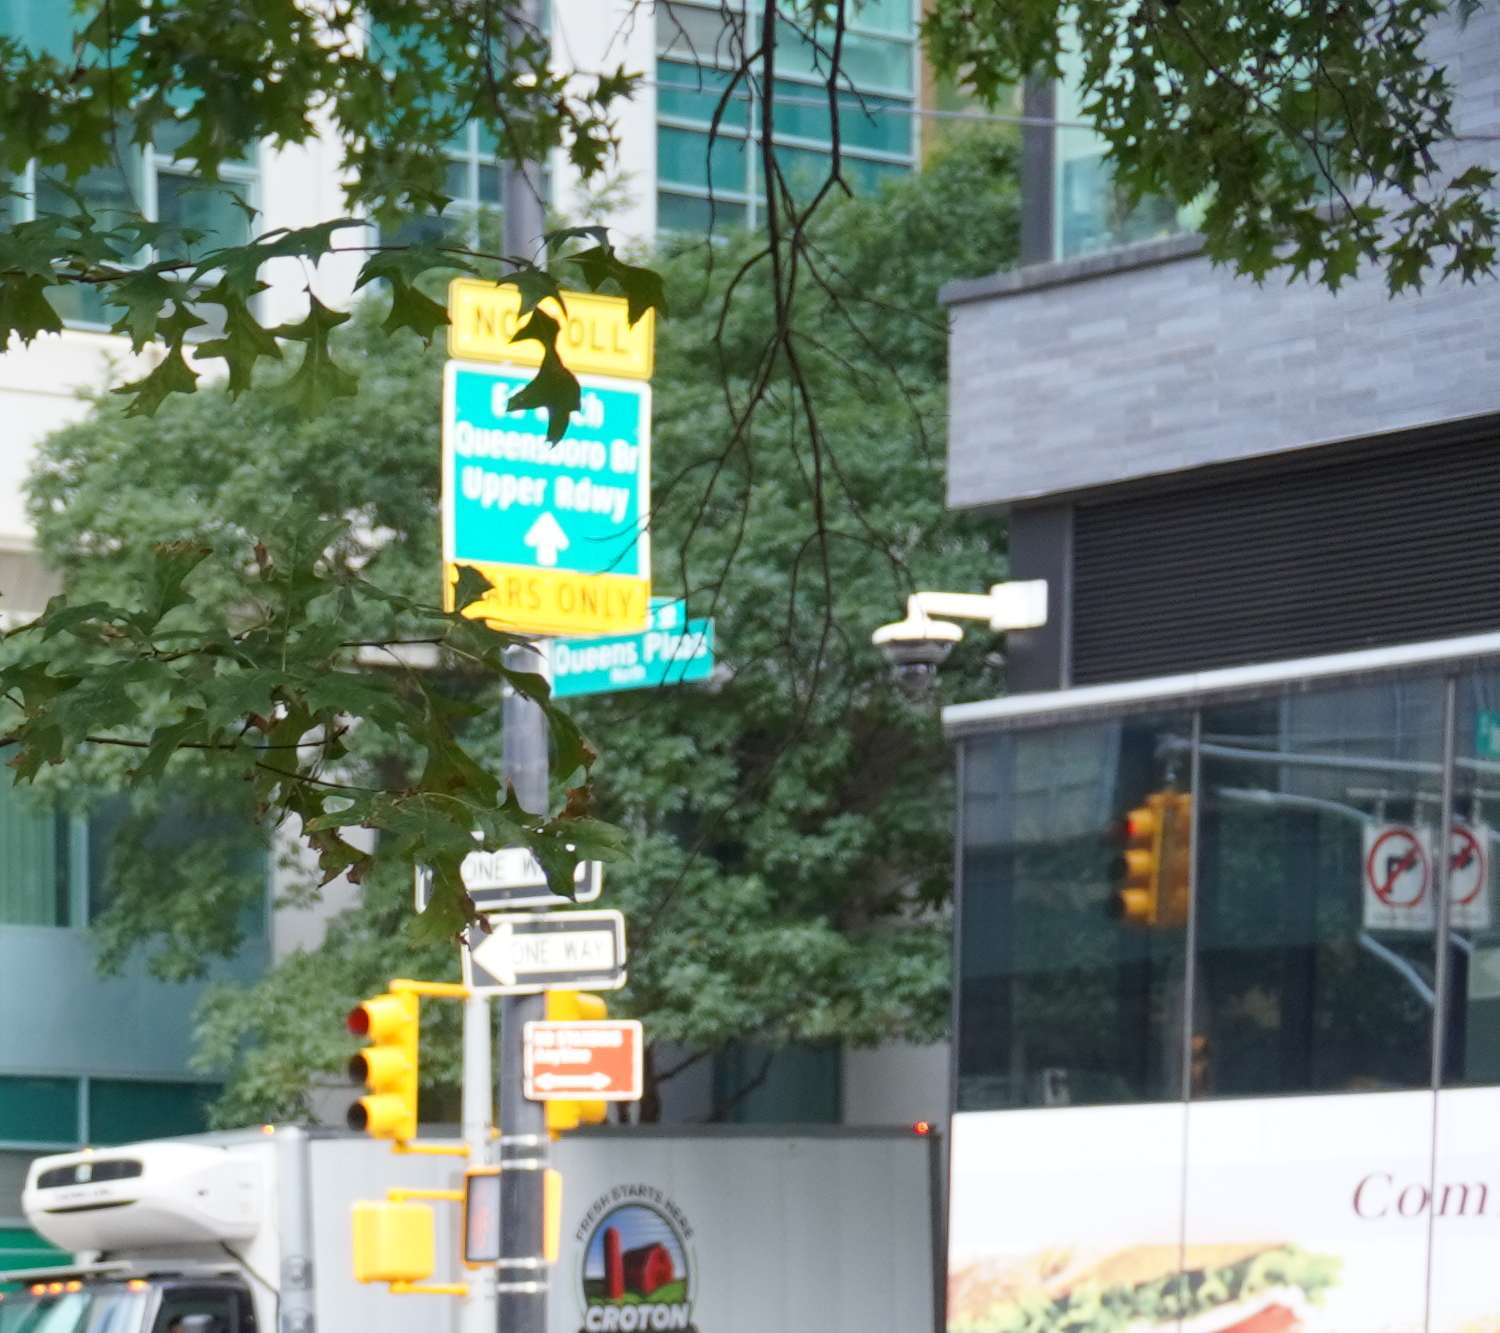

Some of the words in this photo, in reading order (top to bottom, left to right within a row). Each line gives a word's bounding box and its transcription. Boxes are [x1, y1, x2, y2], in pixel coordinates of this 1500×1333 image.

[567, 318, 628, 354] OLL
[455, 421, 606, 470] Queensboro
[612, 440, 639, 471] Br
[463, 467, 546, 506] Upper
[556, 477, 629, 522] Rdwy
[487, 577, 540, 610] ARS
[558, 584, 633, 617] ONLY
[555, 642, 637, 675] Queens
[463, 856, 508, 882] ONE
[512, 940, 550, 965] ONE
[565, 939, 603, 962] WAY
[576, 1194, 610, 1241] FRESH
[611, 1184, 663, 1202] STARTS
[586, 1302, 690, 1332] CROTON
